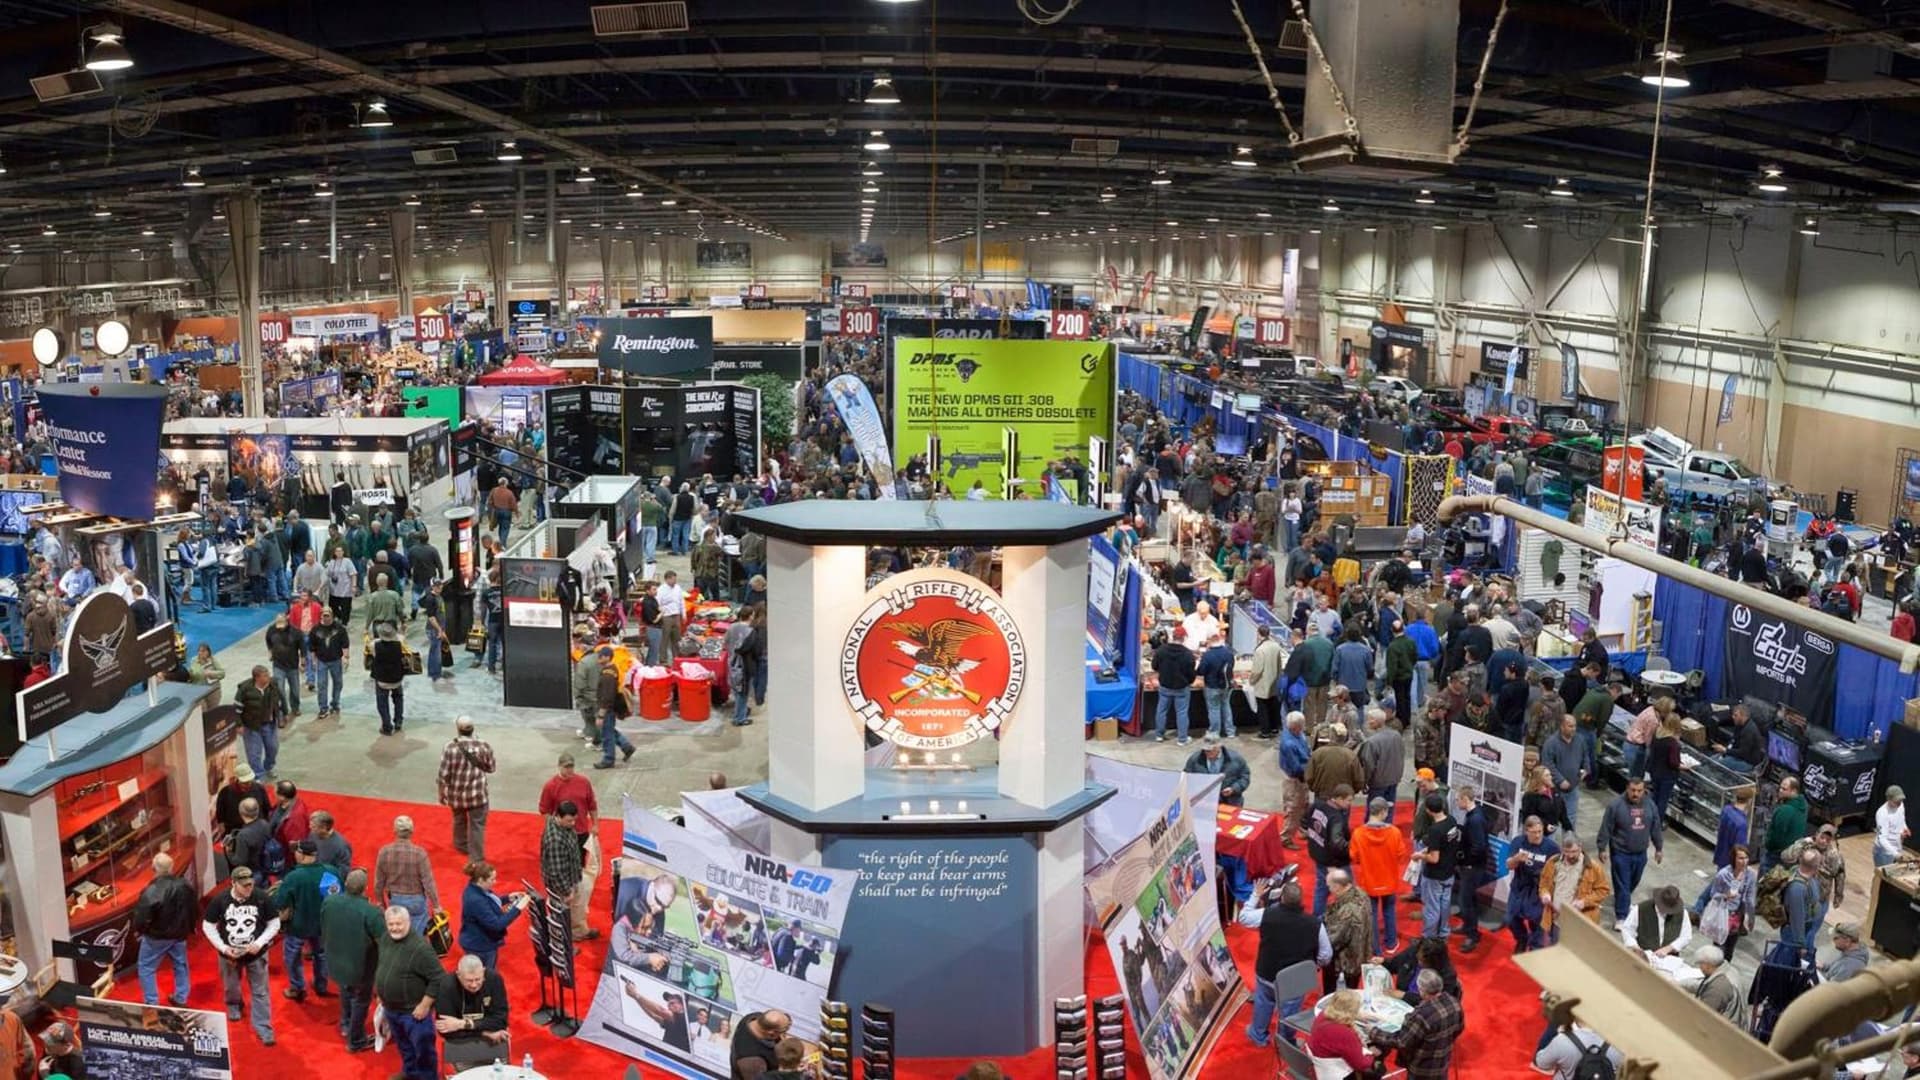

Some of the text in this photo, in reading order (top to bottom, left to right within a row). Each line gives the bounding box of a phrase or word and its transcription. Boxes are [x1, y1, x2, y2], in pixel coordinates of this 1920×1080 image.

[261, 322, 283, 342] 600
[324, 318, 368, 329] COLD STEEL
[420, 318, 444, 338] 500
[846, 312, 873, 333] 300
[1057, 314, 1084, 335] 200
[1262, 321, 1284, 342] 100
[612, 334, 696, 354] Remington
[910, 353, 956, 365] DPMS
[907, 395, 930, 405] THE
[934, 395, 961, 405] NEW
[964, 395, 1000, 405] DPMS
[907, 407, 1097, 418] MAKING ALL OTHERS OBSOLETE
[52, 438, 86, 461] Center
[913, 584, 959, 596] RIFLE
[1753, 622, 1807, 675] Eagle
[1807, 634, 1832, 652] BERSA
[844, 616, 873, 697] NATIONAL
[986, 606, 1022, 703] ASSOCIATION
[894, 708, 970, 717] INCORPORATED
[921, 722, 944, 731] 1871
[897, 733, 975, 748] OF AMERICA
[890, 852, 923, 869] right
[927, 850, 943, 869] of
[944, 850, 965, 865] the
[965, 849, 1009, 869] people
[859, 866, 1007, 884] to keep and bear arms
[706, 863, 767, 901] EDUCATE
[786, 889, 830, 920] TRAIN
[858, 882, 890, 897] shall
[895, 886, 917, 897] not
[921, 882, 935, 897] be
